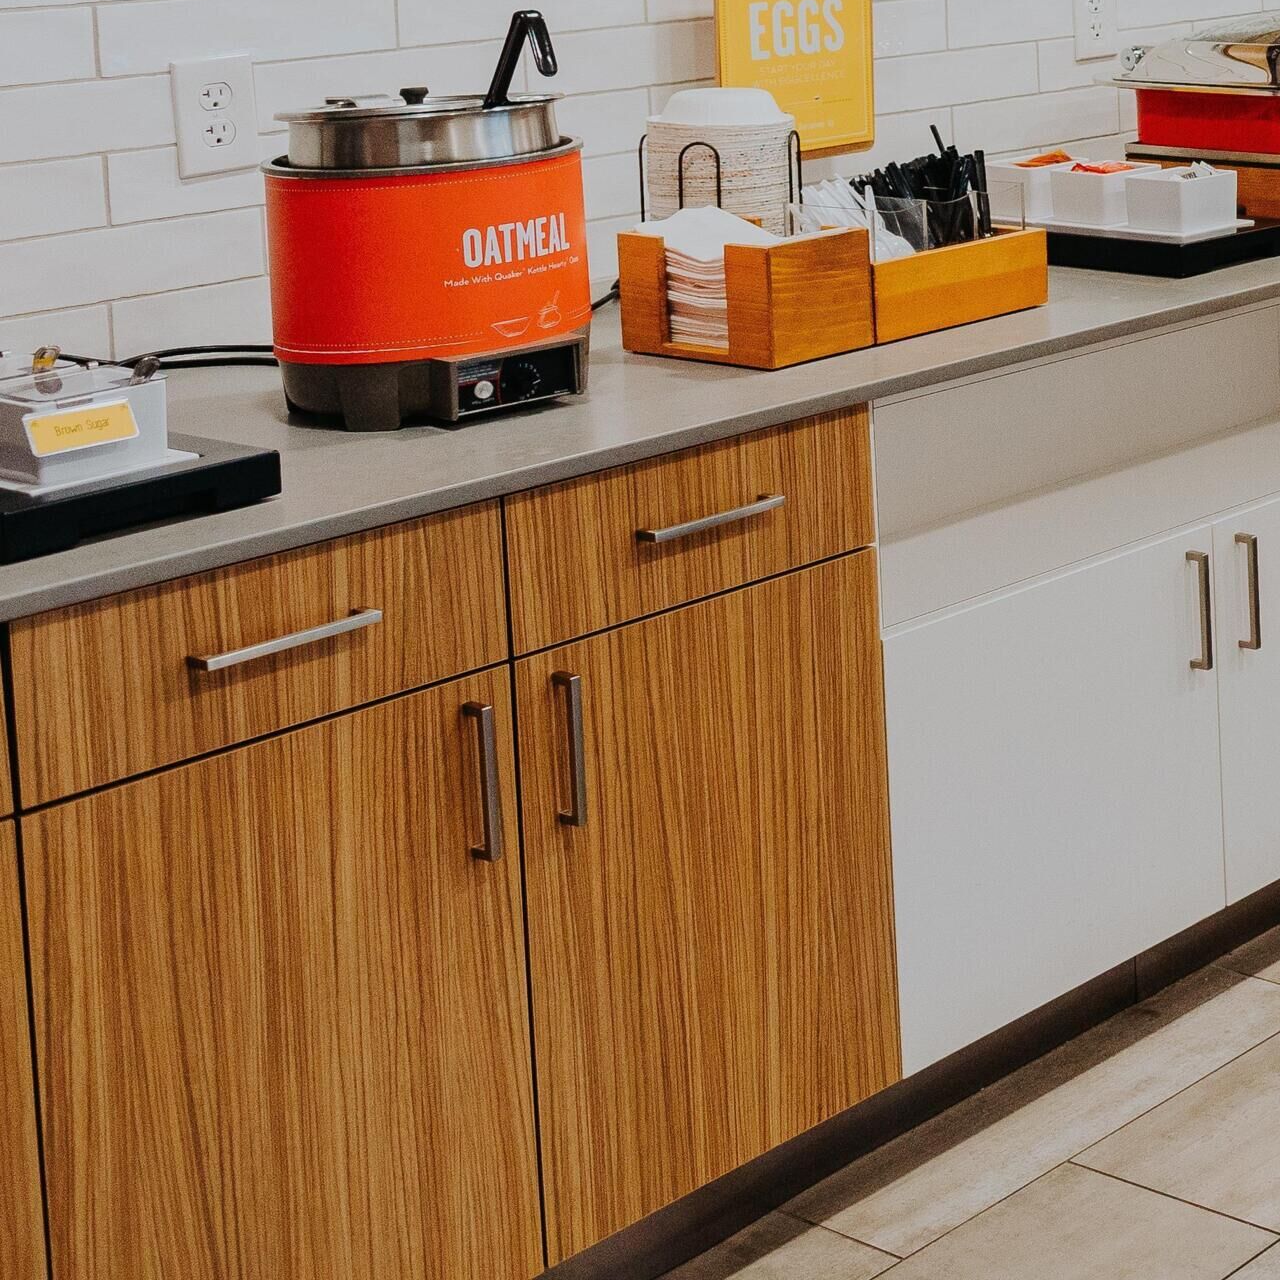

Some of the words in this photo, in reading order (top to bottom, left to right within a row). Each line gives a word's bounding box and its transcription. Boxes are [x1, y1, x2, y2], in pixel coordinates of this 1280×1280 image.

[462, 212, 571, 268] OATMEAL
[444, 278, 470, 288] Made
[472, 274, 493, 284] With
[527, 265, 548, 275] Kettle
[54, 424, 83, 437] Brown
[86, 417, 110, 431] Sugar
